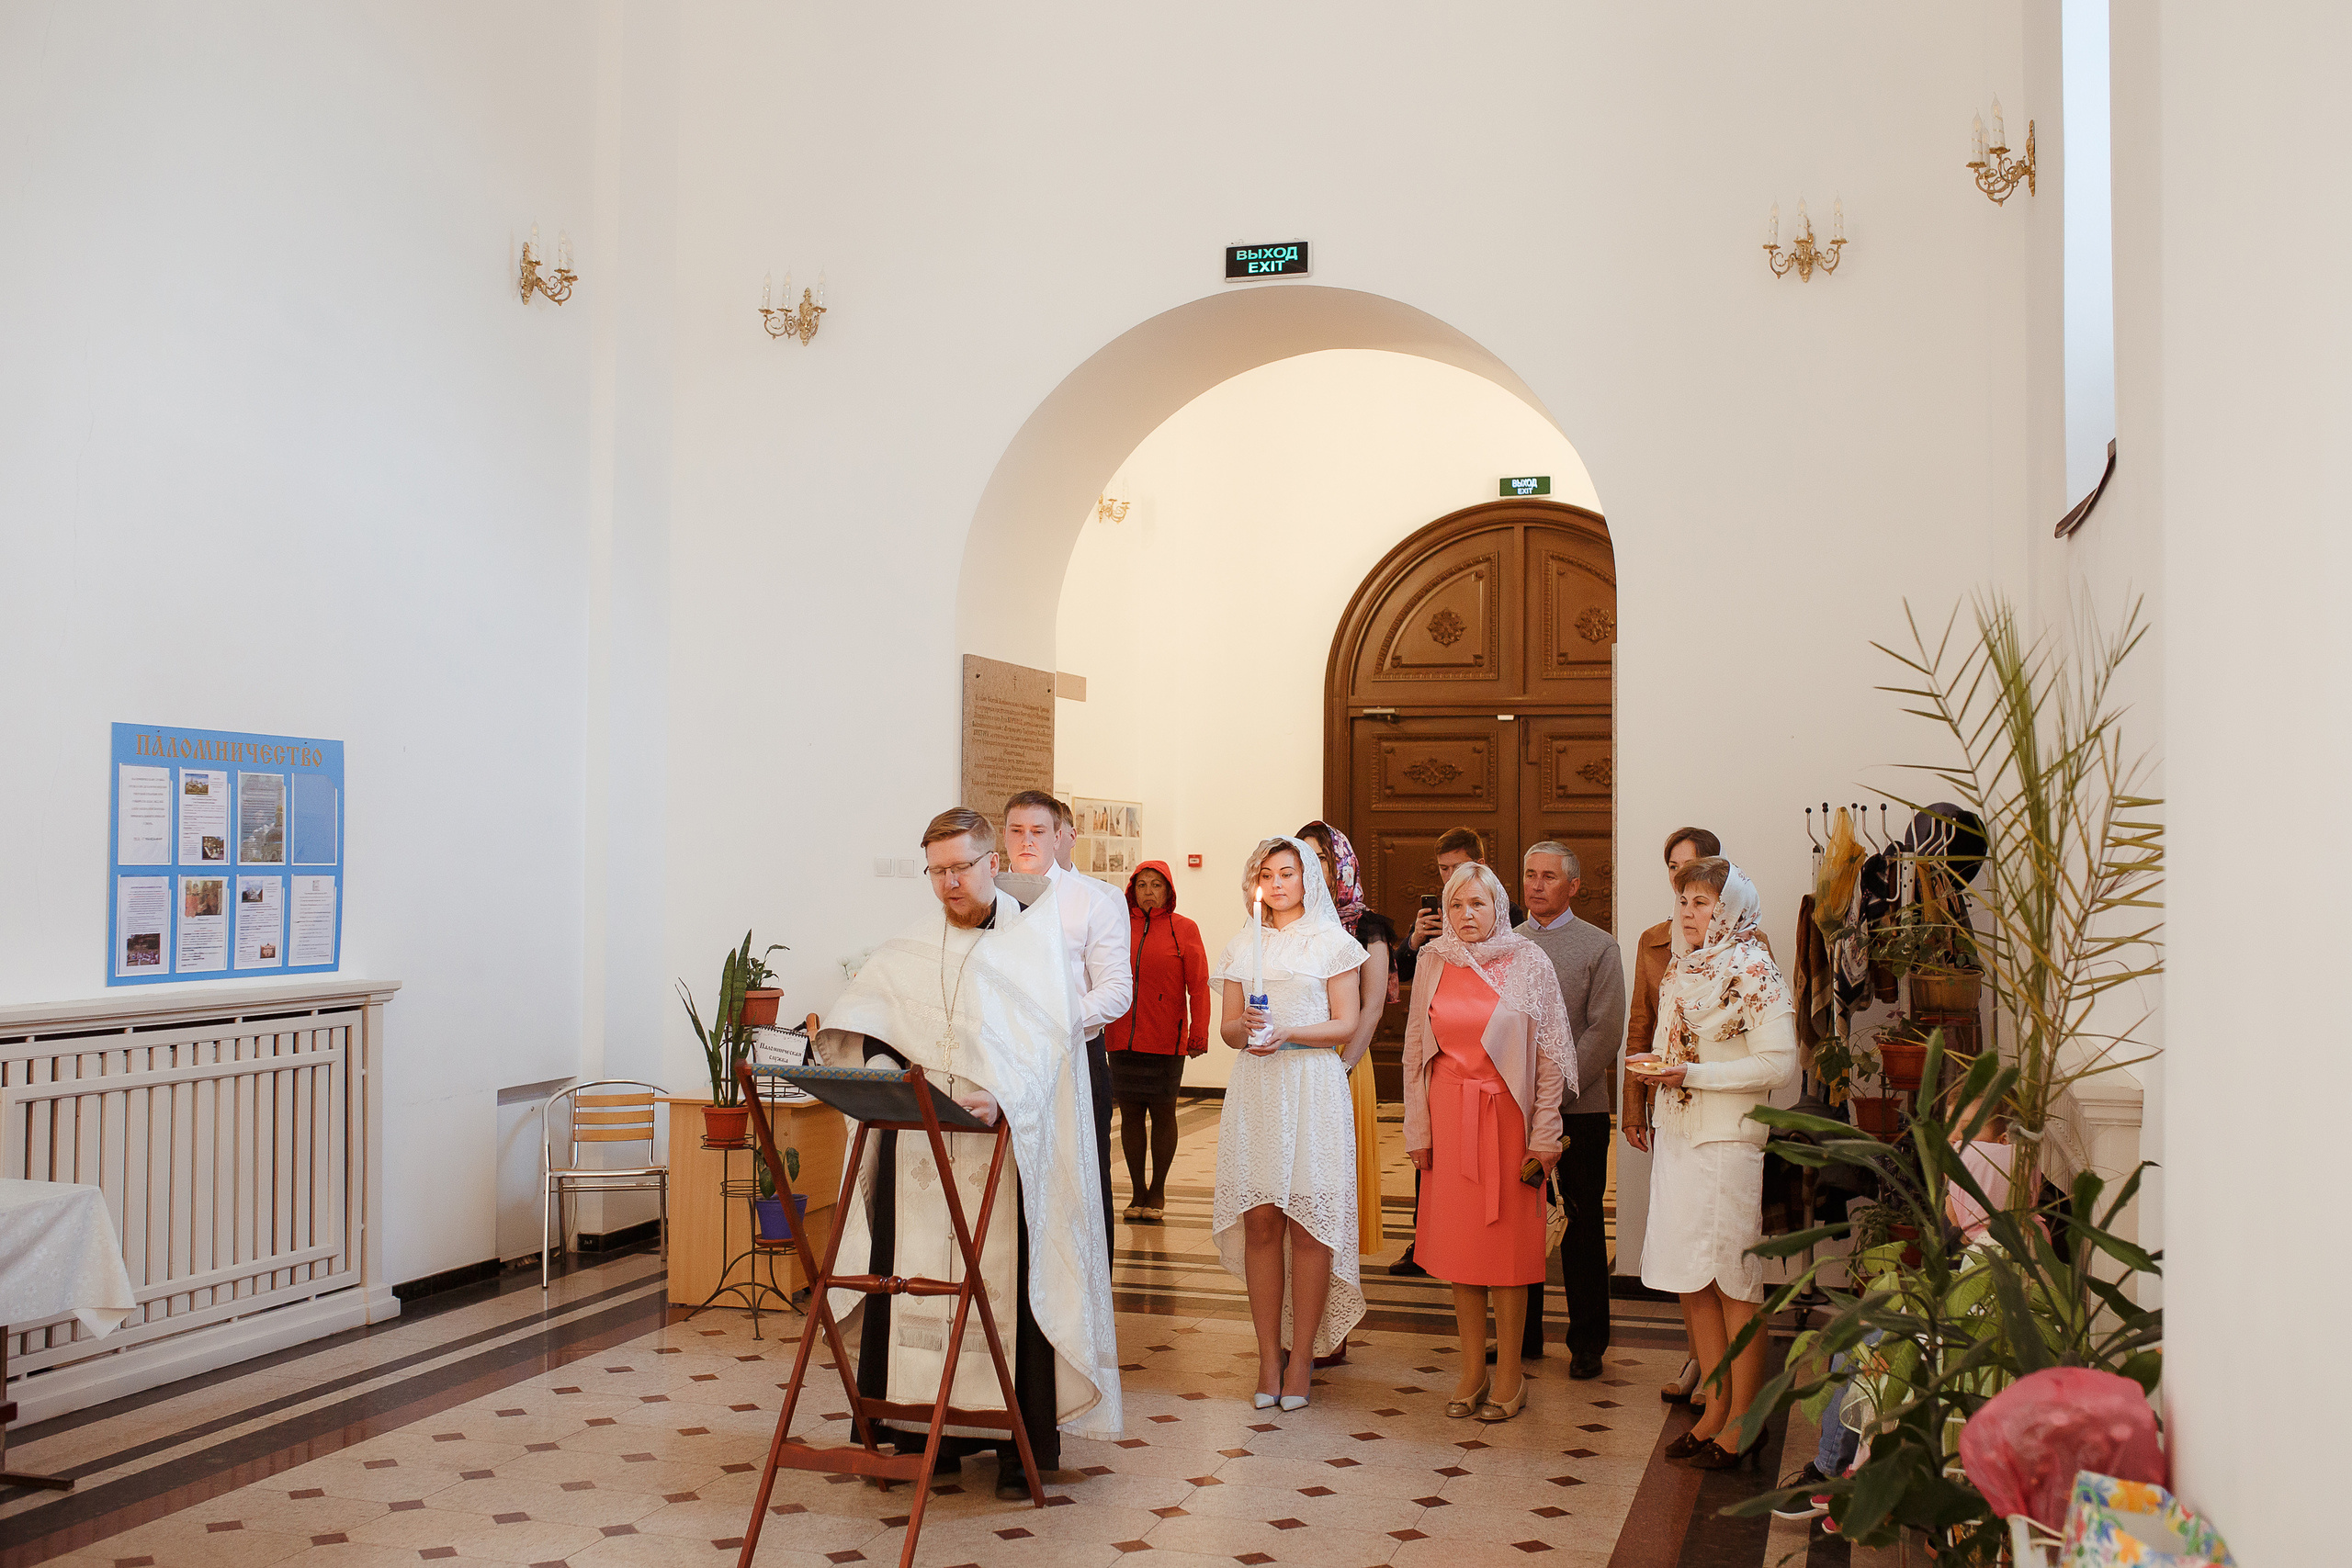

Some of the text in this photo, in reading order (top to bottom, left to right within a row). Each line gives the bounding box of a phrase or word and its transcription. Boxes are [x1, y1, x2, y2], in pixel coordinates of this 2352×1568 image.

[1236, 246, 1298, 261] ВЫХОД
[1248, 260, 1285, 274] EXIT
[1511, 478, 1538, 489] ВЫХОД
[1517, 487, 1533, 495] EXIT
[135, 734, 322, 767] ПАЛОМНИЧЕСТВО
